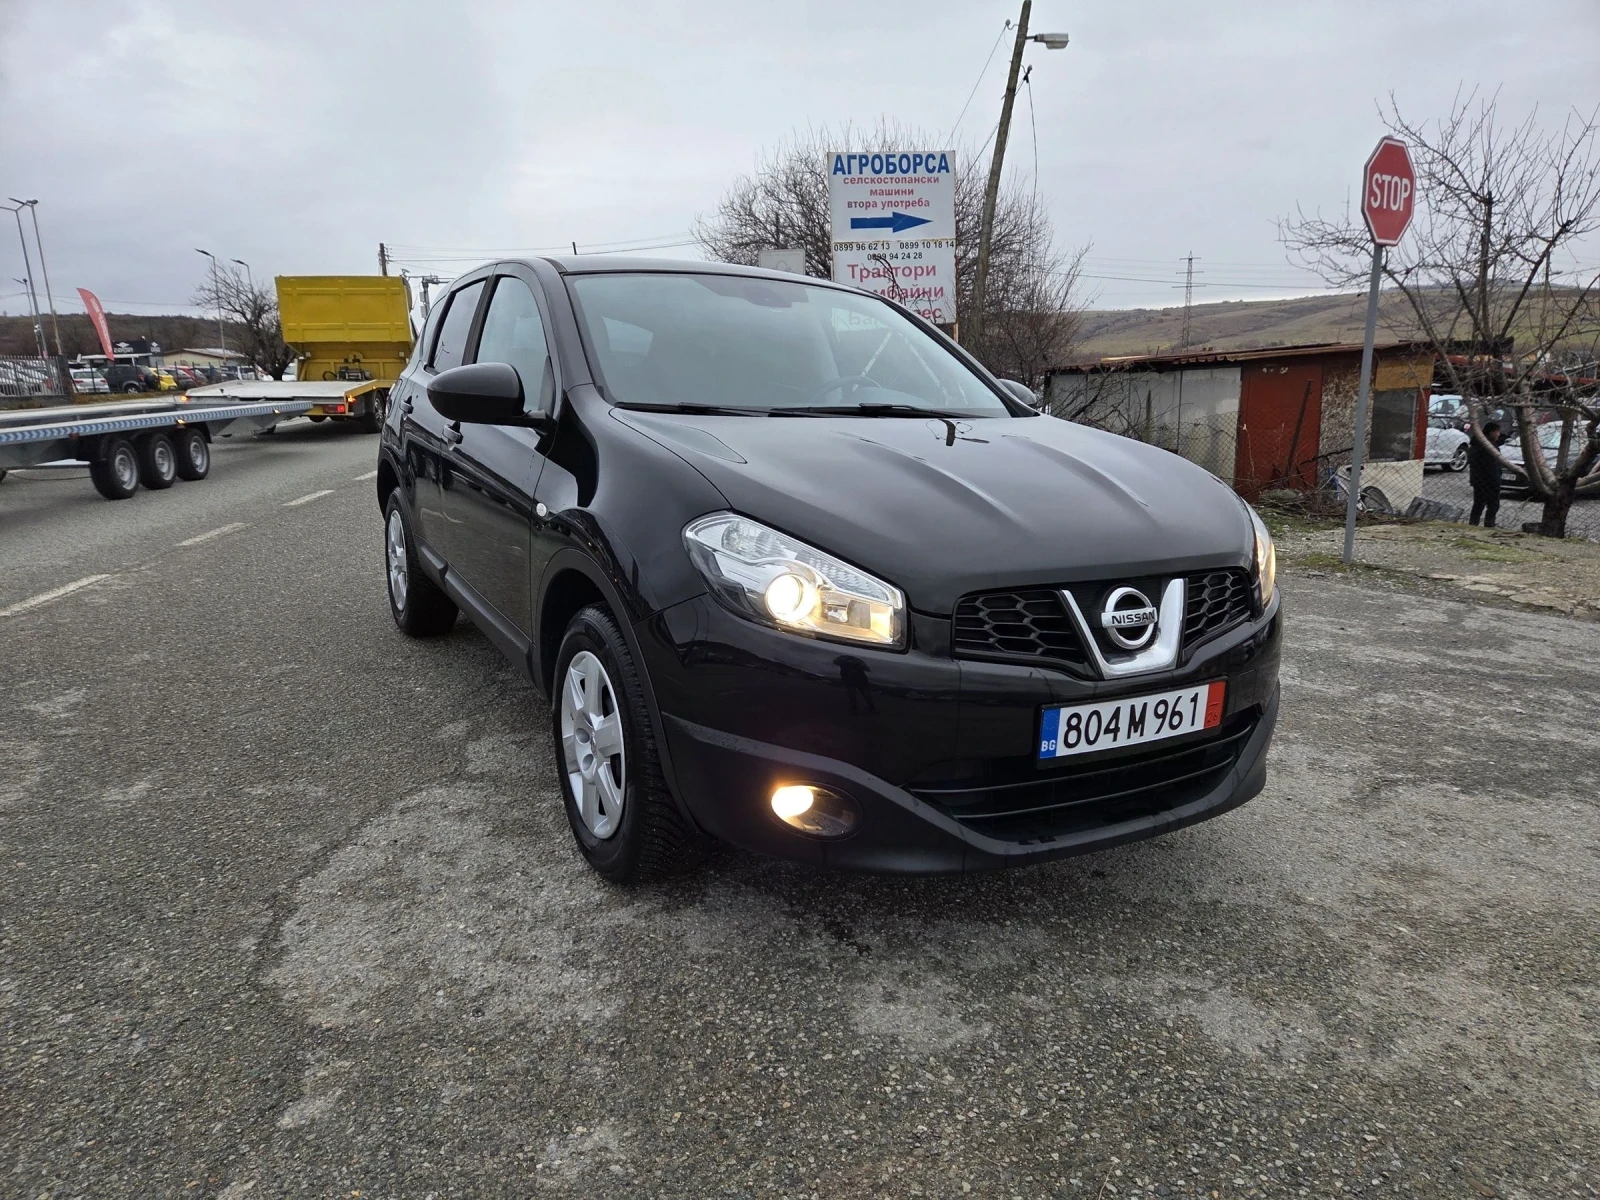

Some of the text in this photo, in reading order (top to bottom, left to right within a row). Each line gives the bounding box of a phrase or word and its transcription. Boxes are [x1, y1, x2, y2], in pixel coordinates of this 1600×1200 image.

[833, 153, 950, 175] АГРОБОРСА
[843, 176, 940, 185] селскостопански
[869, 188, 914, 196] машини
[1370, 173, 1411, 212] STOP
[847, 198, 930, 210] втора употреба
[833, 242, 890, 252] 0899 96 62 13
[900, 240, 954, 250] 0899 10 18 14
[889, 252, 899, 260] 94
[901, 252, 911, 260] 24
[913, 251, 923, 260] 28
[846, 263, 937, 283] Трактори
[1111, 608, 1155, 625] NISSAN
[1063, 692, 1199, 749] 804 M 961
[1041, 739, 1056, 752] BG
